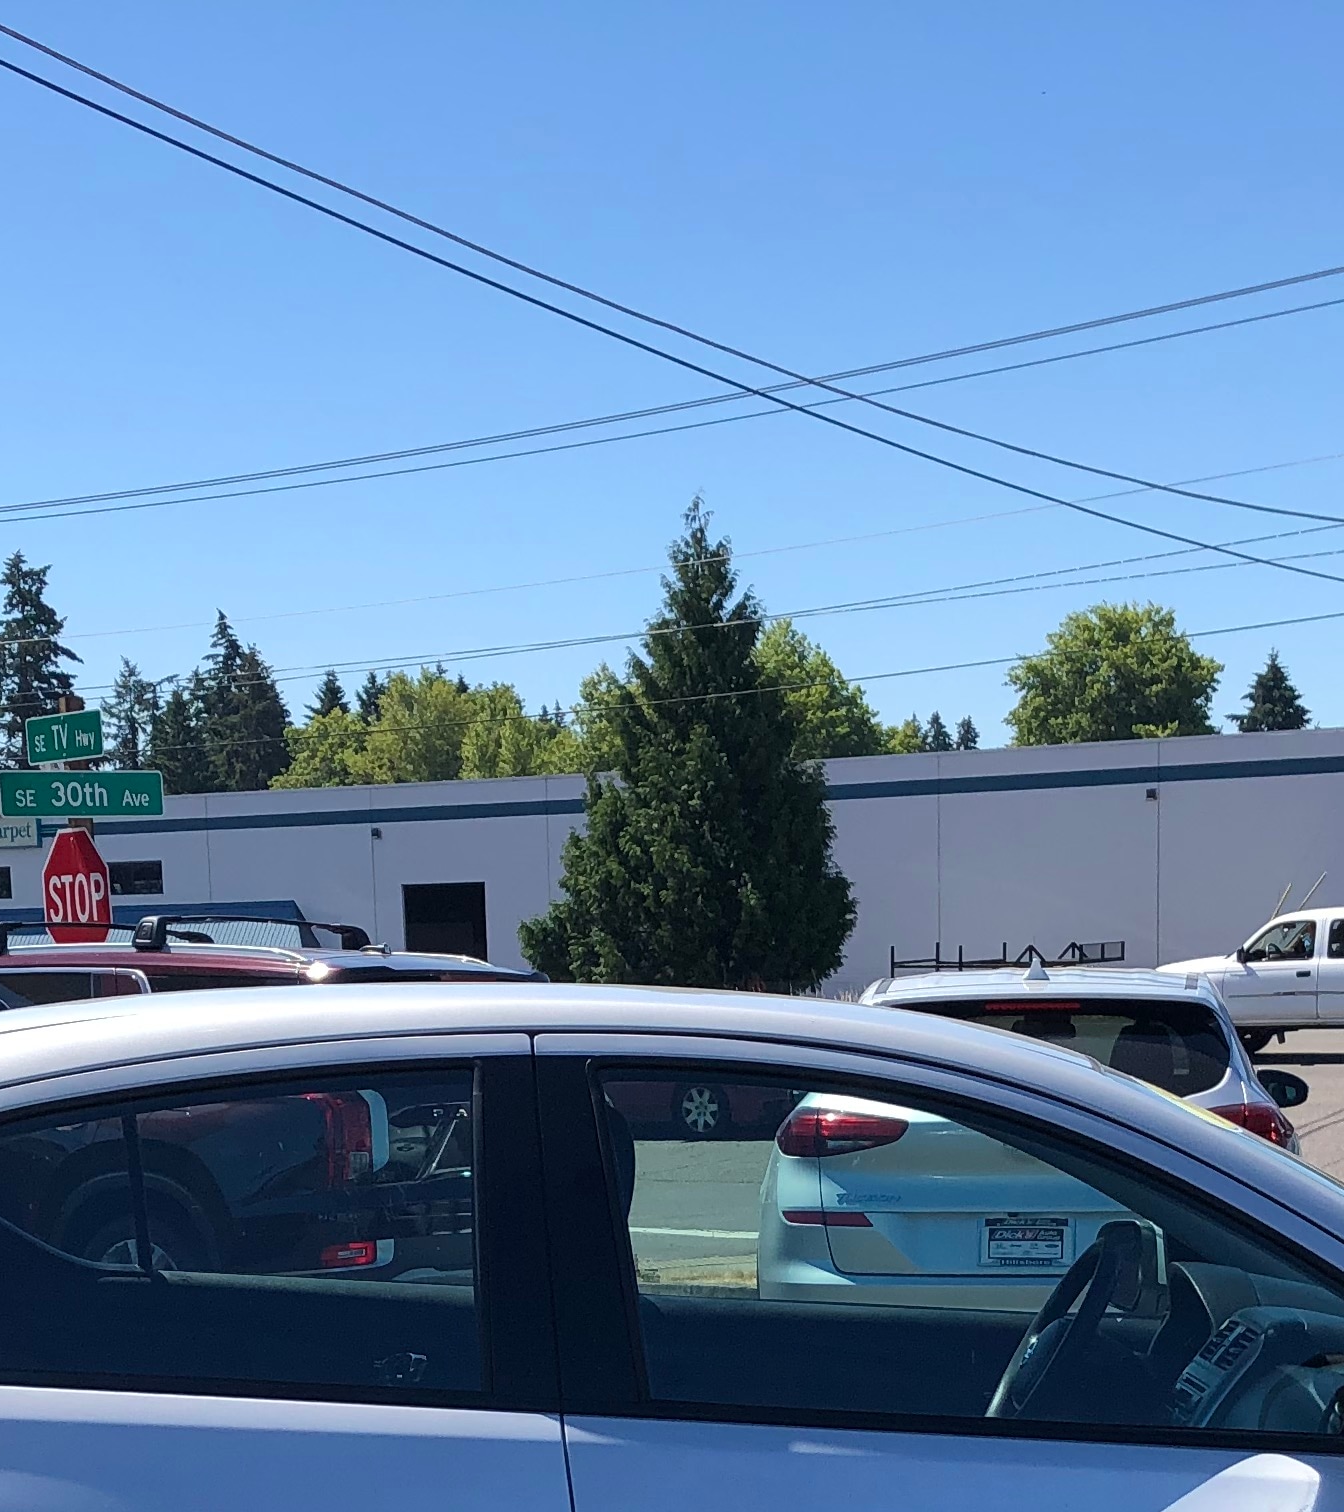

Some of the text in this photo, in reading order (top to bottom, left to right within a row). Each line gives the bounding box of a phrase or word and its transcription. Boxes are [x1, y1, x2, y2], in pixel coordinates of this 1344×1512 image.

[34, 723, 95, 753] SE TV Hwy
[15, 781, 150, 808] SE 30th Ave
[48, 872, 105, 923] STOP
[995, 1230, 1033, 1239] Dick's
